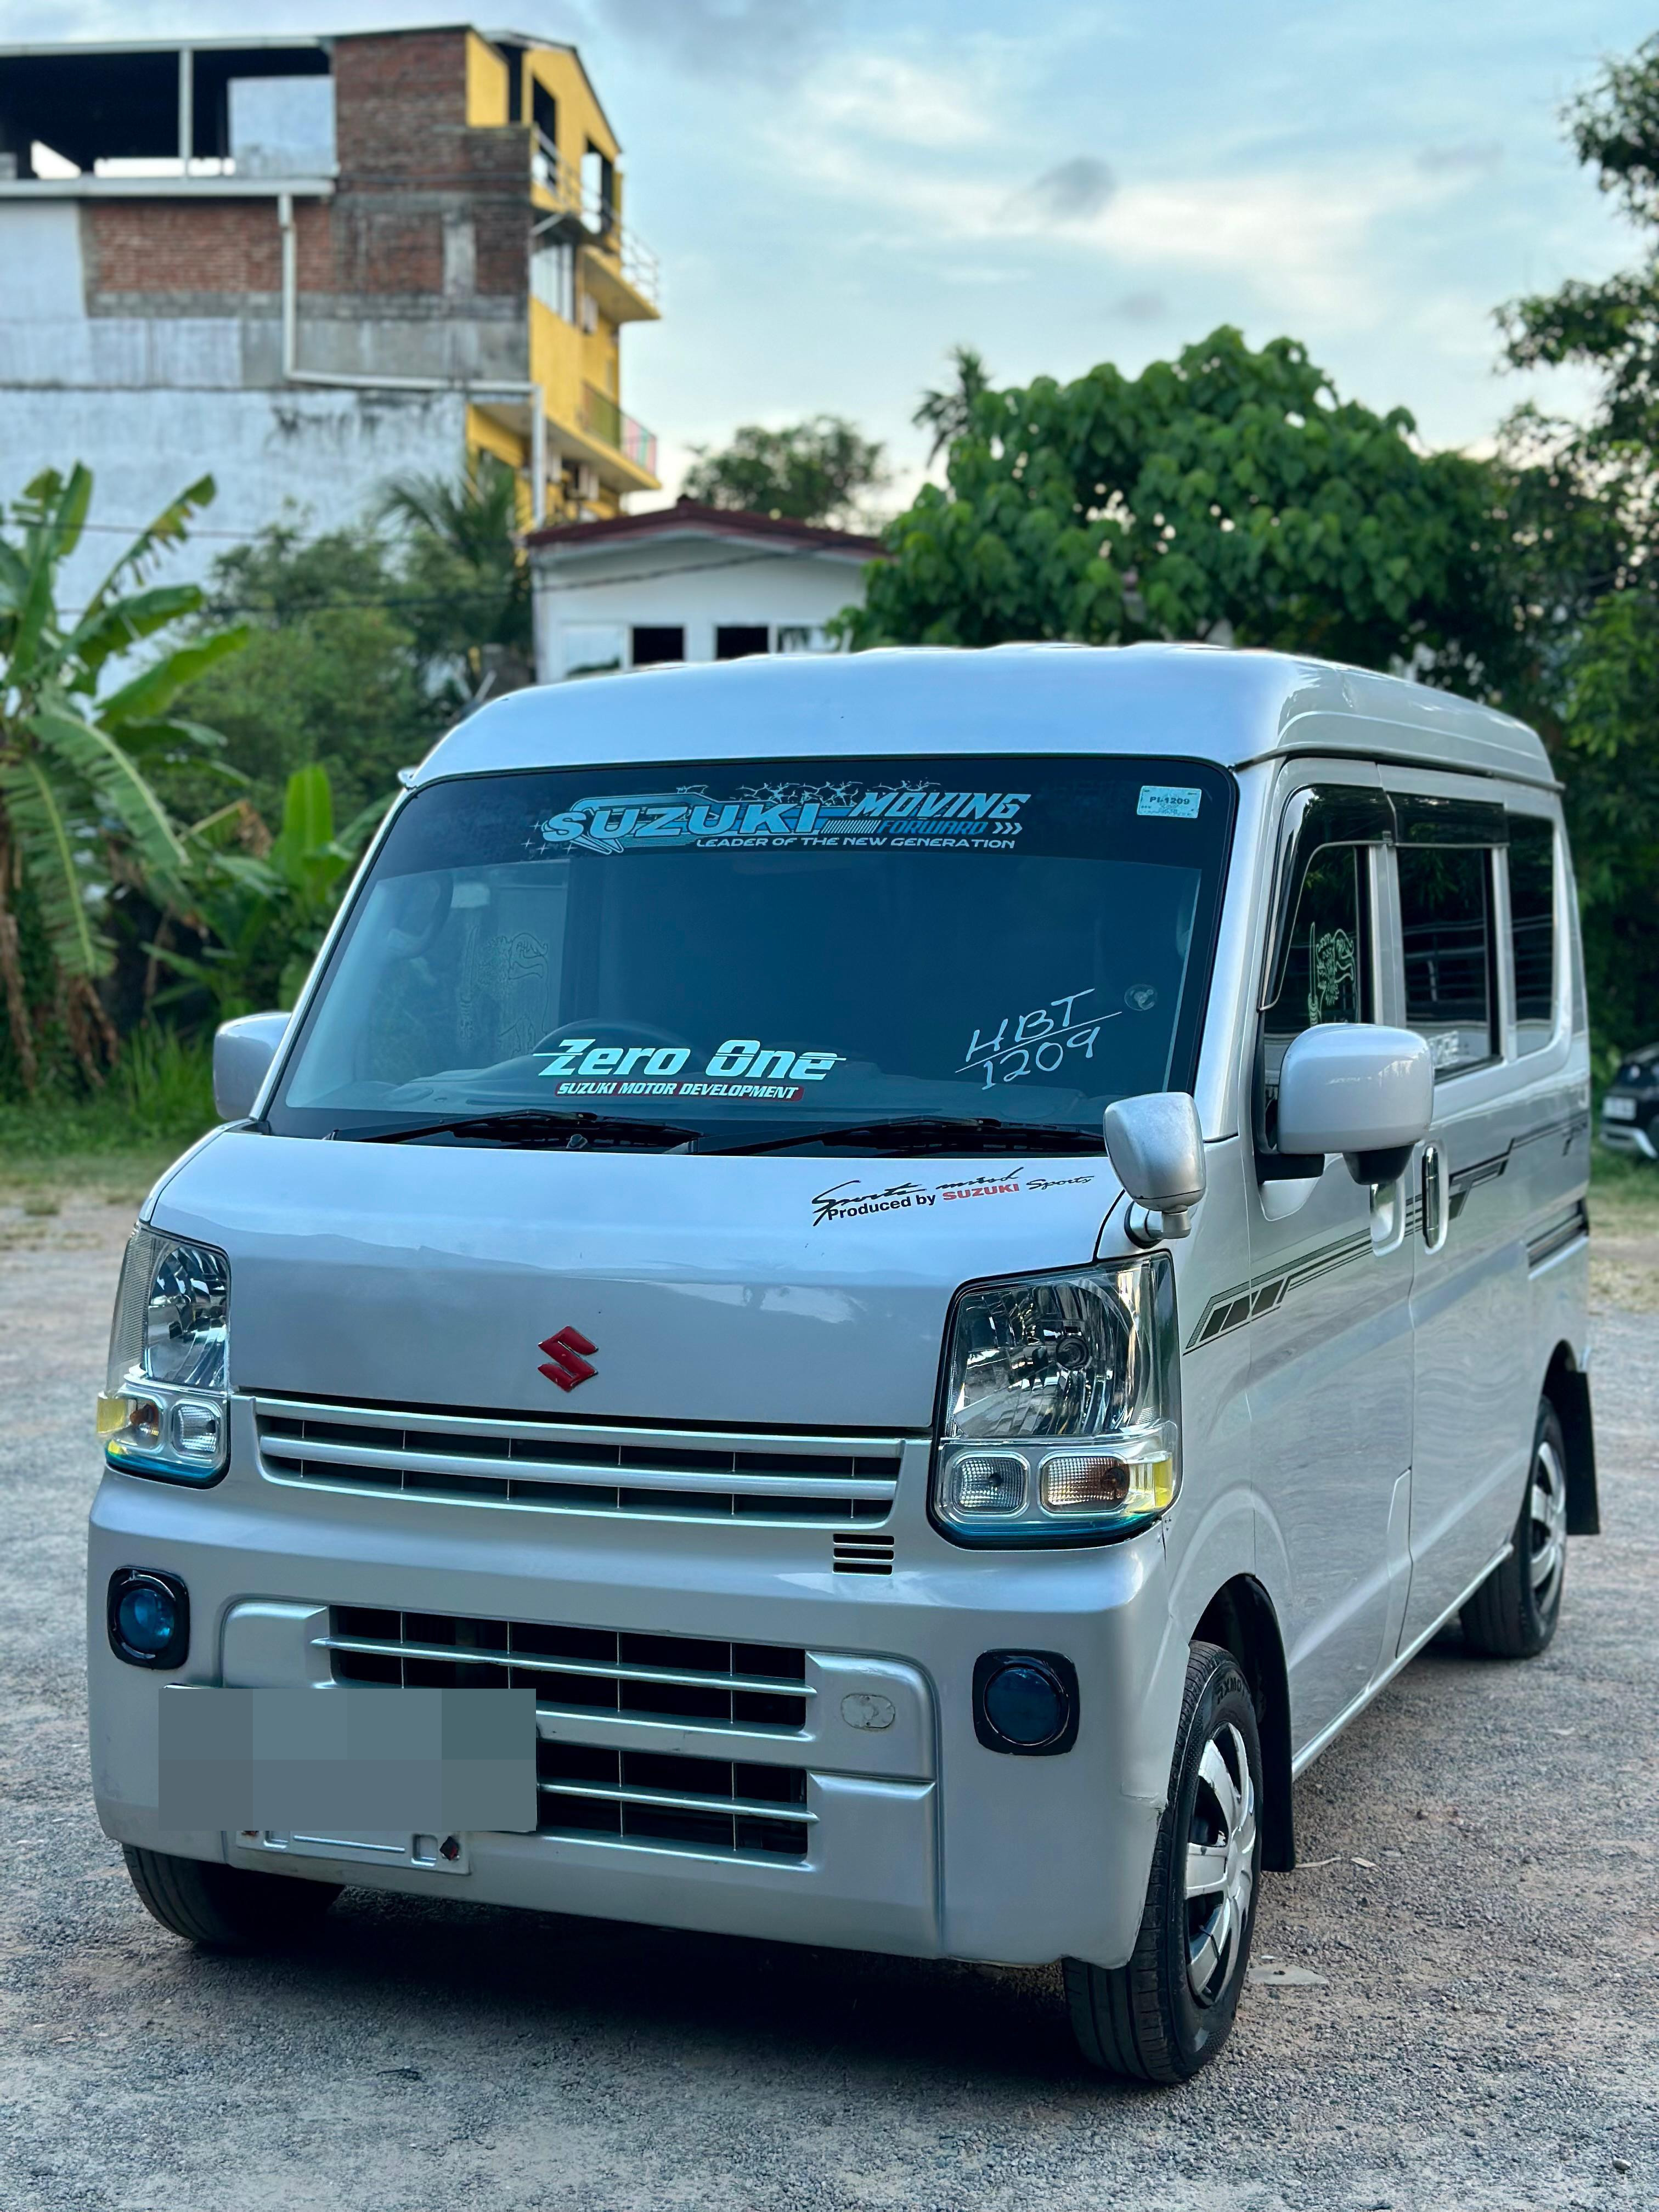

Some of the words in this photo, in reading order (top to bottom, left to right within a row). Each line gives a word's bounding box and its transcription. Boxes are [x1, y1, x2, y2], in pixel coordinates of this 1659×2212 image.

[543, 803, 821, 842] SUZUKI
[848, 792, 1031, 820] MOVING
[877, 820, 989, 836] FORWARD
[697, 838, 769, 848] LEADER
[801, 838, 838, 846] THE
[843, 838, 887, 847] NEW
[891, 838, 1015, 849] GENERATION
[965, 988, 1096, 1063] HBT
[532, 1039, 691, 1076] Zero
[706, 1039, 847, 1080] One
[981, 1026, 1101, 1091] 1209
[557, 1082, 617, 1095] SUZUKI
[618, 1083, 678, 1096] MOTOR
[680, 1084, 799, 1099] DEVELOPMENT
[828, 1196, 911, 1221] Produced
[916, 1194, 935, 1206] by
[943, 1183, 1019, 1200] SUZUKI
[1026, 1175, 1094, 1190] Sports
